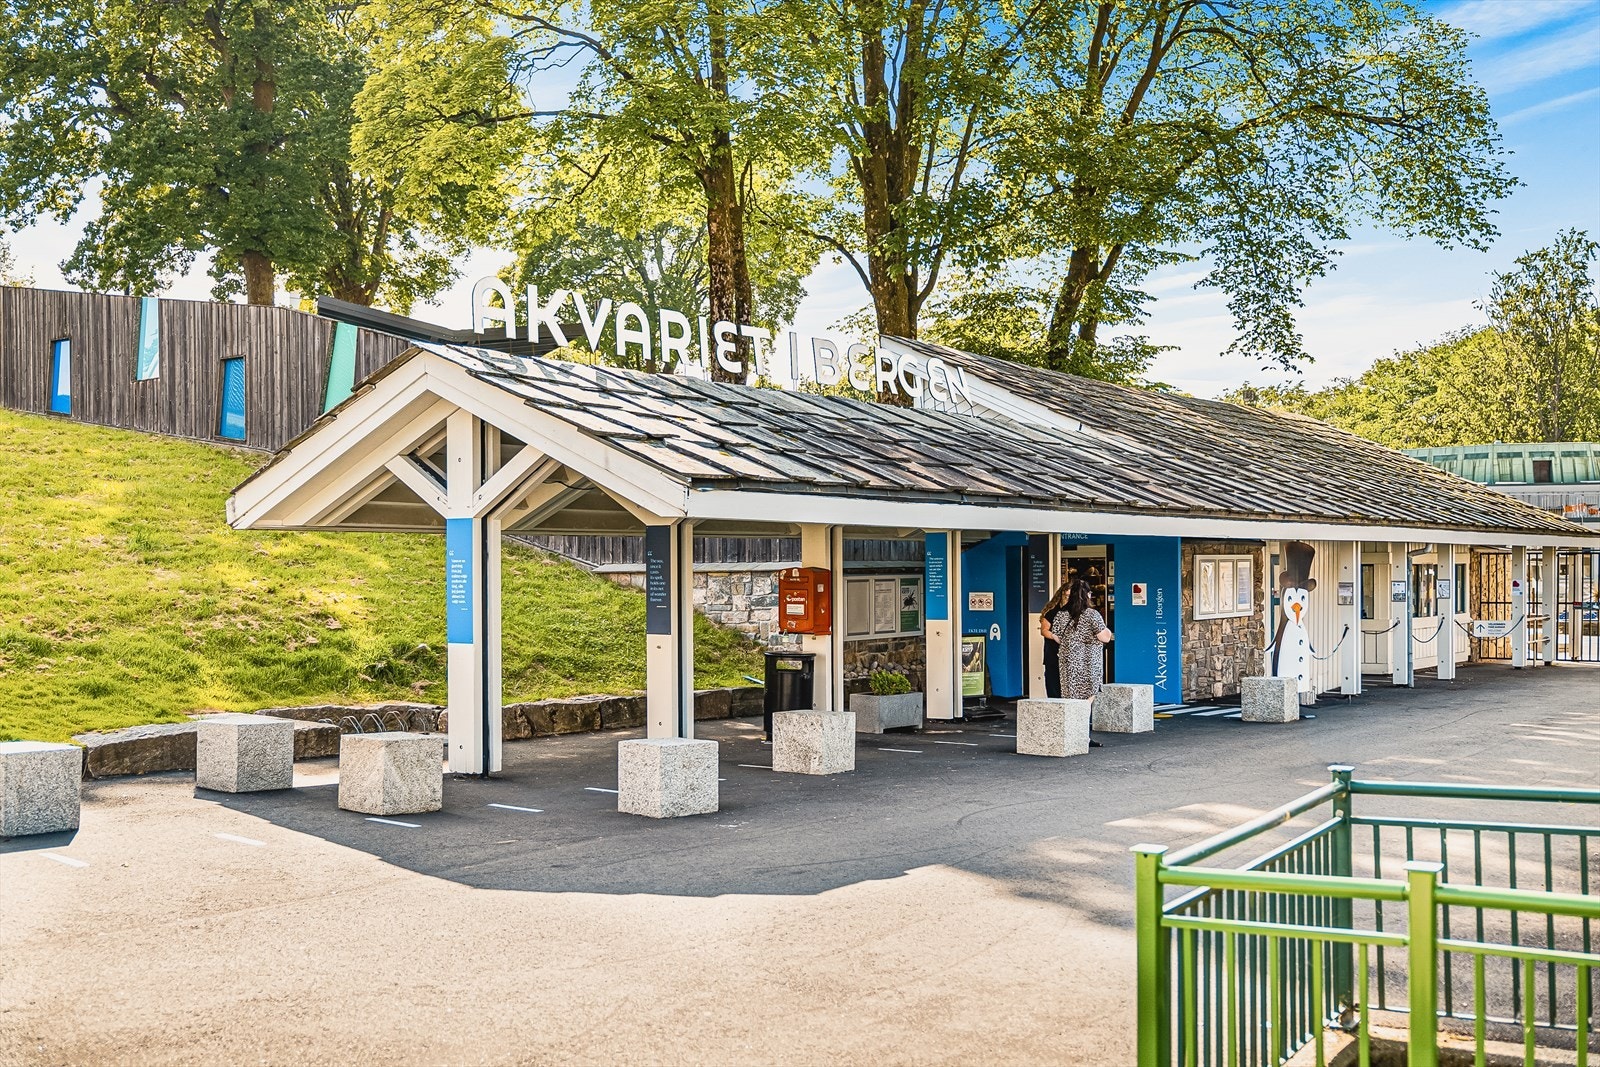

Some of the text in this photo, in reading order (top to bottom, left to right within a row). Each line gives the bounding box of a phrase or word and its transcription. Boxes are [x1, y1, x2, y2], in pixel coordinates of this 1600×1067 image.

[472, 276, 974, 408] AKVARIET I BERGEN
[1061, 532, 1089, 540] NTRANCE
[1155, 587, 1165, 616] Bergen
[1154, 628, 1168, 691] Akvariet
